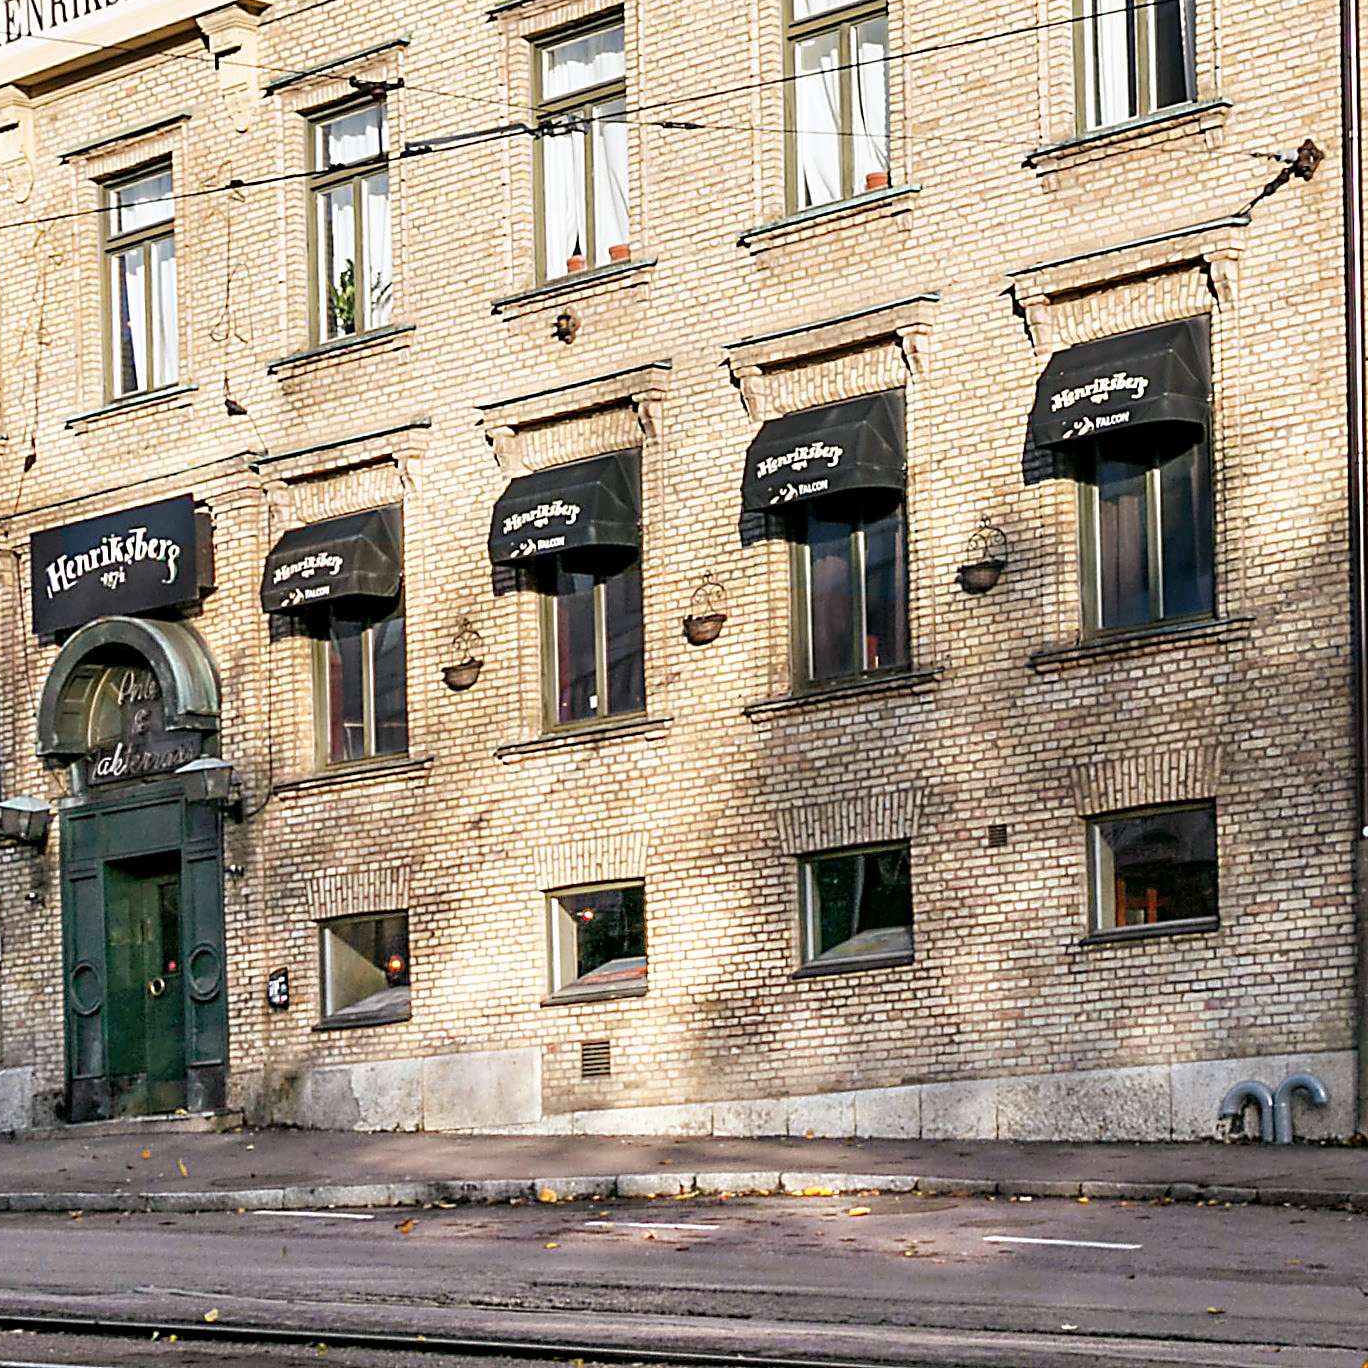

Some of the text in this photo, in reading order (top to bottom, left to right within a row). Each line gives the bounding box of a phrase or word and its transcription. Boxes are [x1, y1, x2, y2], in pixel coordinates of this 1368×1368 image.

[1050, 372, 1149, 412] Henriksberg
[1095, 411, 1130, 428] FALCON
[756, 441, 843, 479] Henriksberg
[798, 479, 828, 495] FALCON
[503, 500, 581, 535] Henriksberg
[45, 527, 181, 599] Henriksberg
[273, 552, 344, 585] Henriksberg
